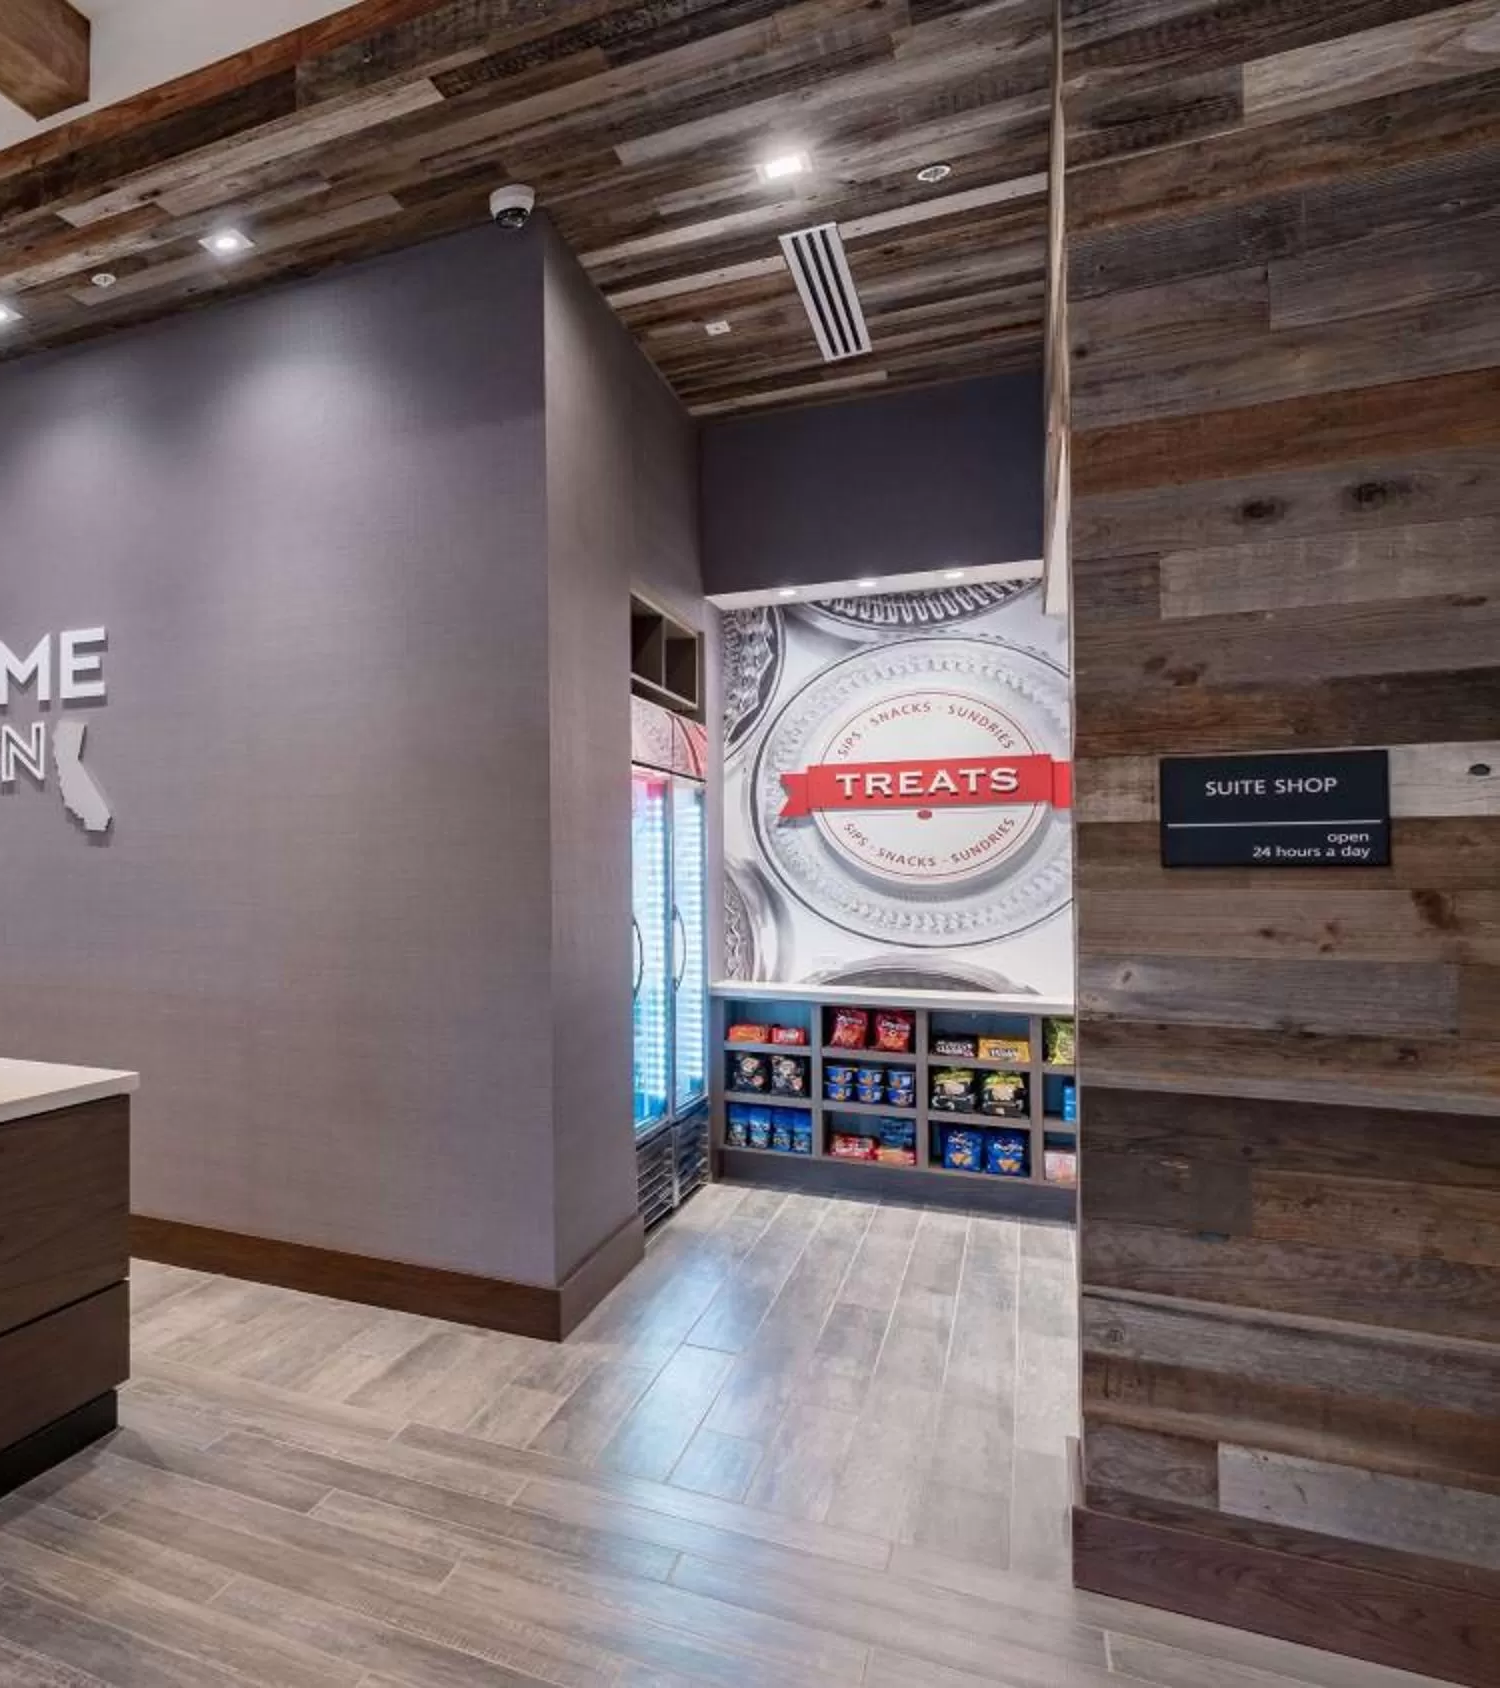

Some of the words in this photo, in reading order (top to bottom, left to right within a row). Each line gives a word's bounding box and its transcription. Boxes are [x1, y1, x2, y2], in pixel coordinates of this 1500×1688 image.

[837, 730, 861, 758] SIPS
[869, 700, 932, 726] SNACKS
[947, 703, 1015, 750] SUNDRIES
[835, 767, 1019, 799] TREATS
[1205, 778, 1267, 797] SUITE
[1274, 776, 1339, 795] SHOP
[843, 822, 868, 847] SIPS
[876, 847, 936, 868] SNACKS
[950, 816, 1015, 863] SUNDRIES
[1327, 832, 1370, 845] open
[1252, 846, 1272, 858] 24
[1275, 845, 1322, 858] hours
[1326, 847, 1336, 858] a
[1341, 844, 1371, 860] day
